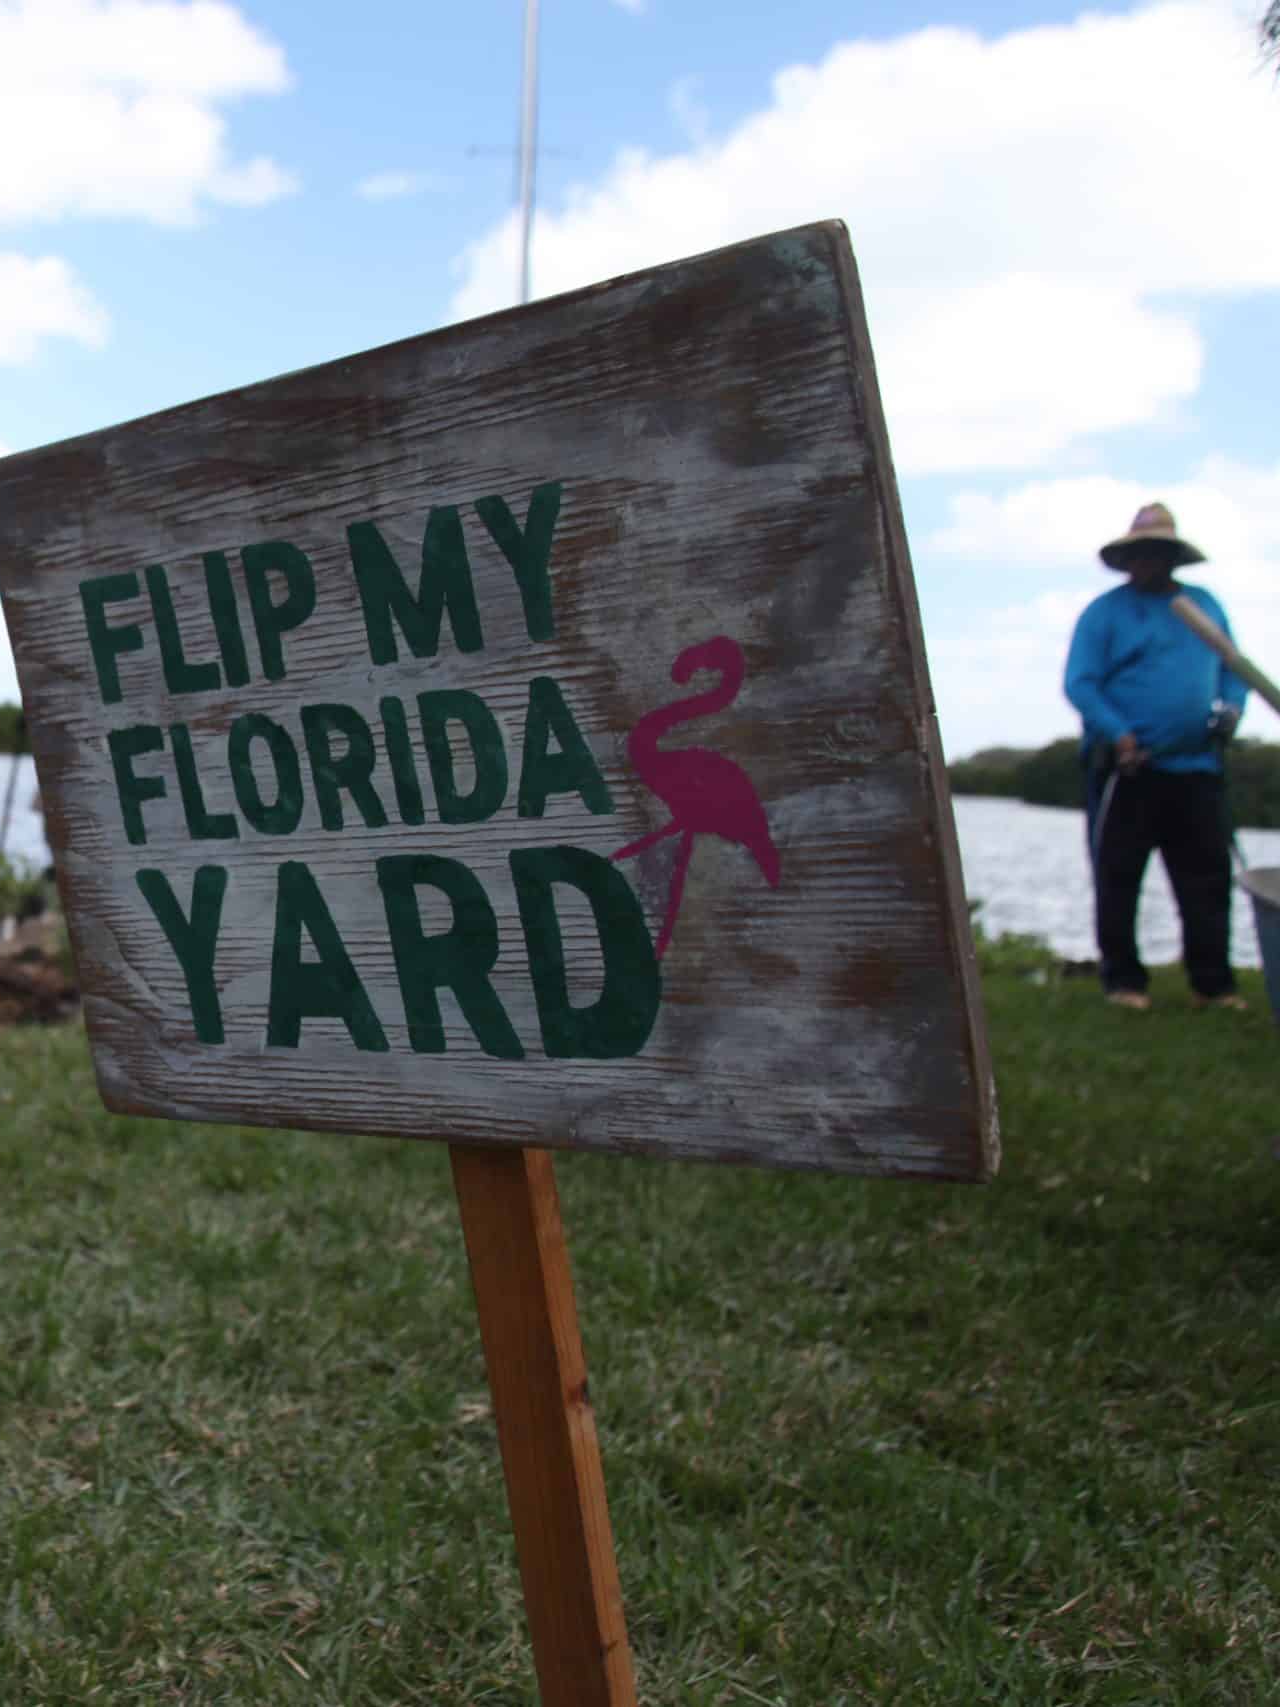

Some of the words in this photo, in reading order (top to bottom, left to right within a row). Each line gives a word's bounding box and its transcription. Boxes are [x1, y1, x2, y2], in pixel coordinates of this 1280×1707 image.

[79, 541, 317, 704] FLIP
[345, 482, 563, 665] MY
[108, 677, 615, 845] FLORIDA
[136, 846, 662, 1060] YARD
